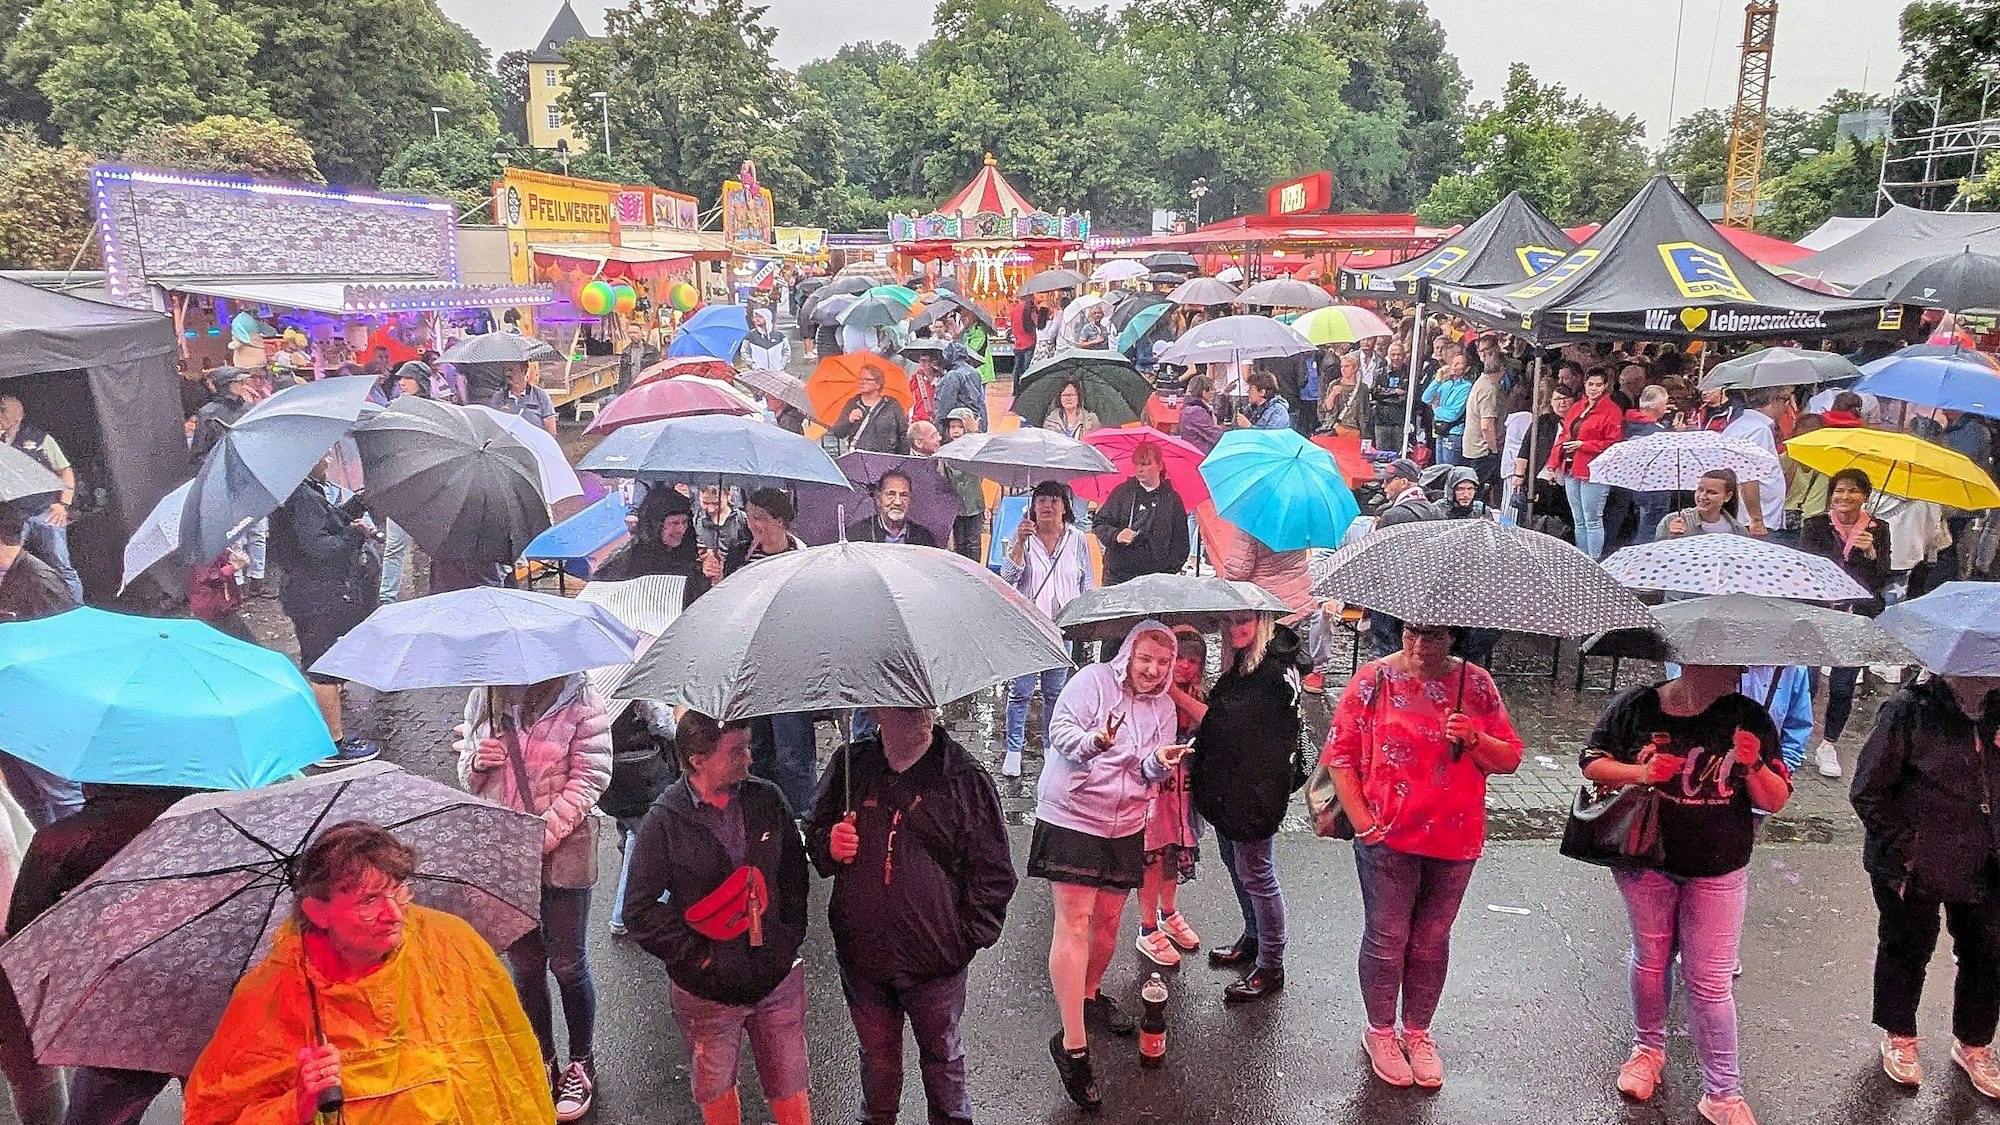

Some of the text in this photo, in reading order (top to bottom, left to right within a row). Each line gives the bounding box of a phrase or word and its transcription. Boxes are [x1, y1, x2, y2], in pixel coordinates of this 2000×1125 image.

[528, 193, 608, 224] PFEILWERFEN
[1645, 309, 1827, 332] Wir Lebensmittel.
